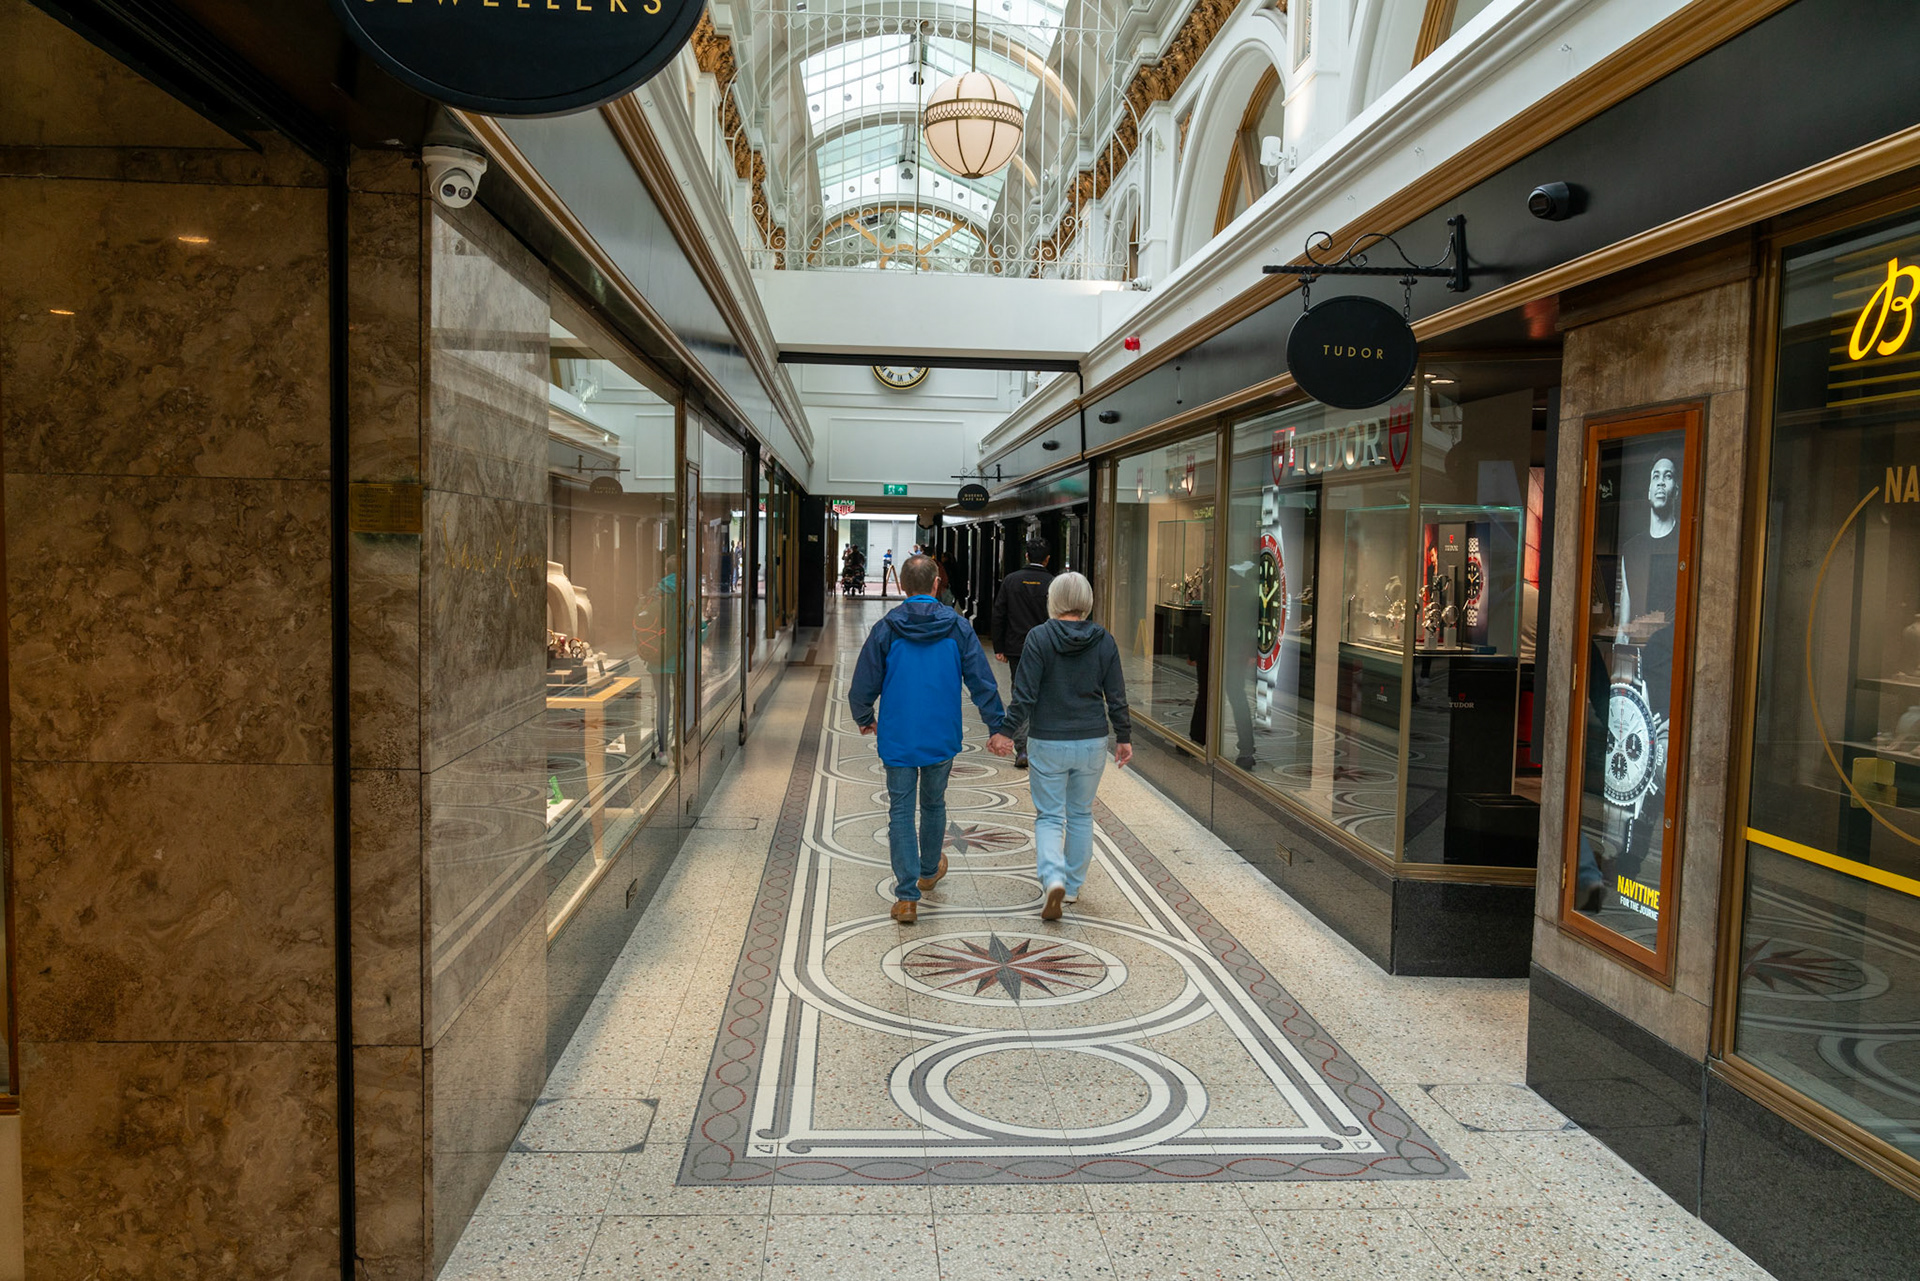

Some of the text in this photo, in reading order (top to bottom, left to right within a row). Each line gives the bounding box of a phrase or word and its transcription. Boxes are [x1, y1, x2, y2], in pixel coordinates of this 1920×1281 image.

[1323, 344, 1384, 360] TUDOR
[1289, 417, 1381, 476] TUDOR
[1884, 465, 1920, 504] NA
[1448, 701, 1475, 709] TUDOR
[1620, 895, 1630, 908] FOR
[1629, 899, 1640, 913] THE
